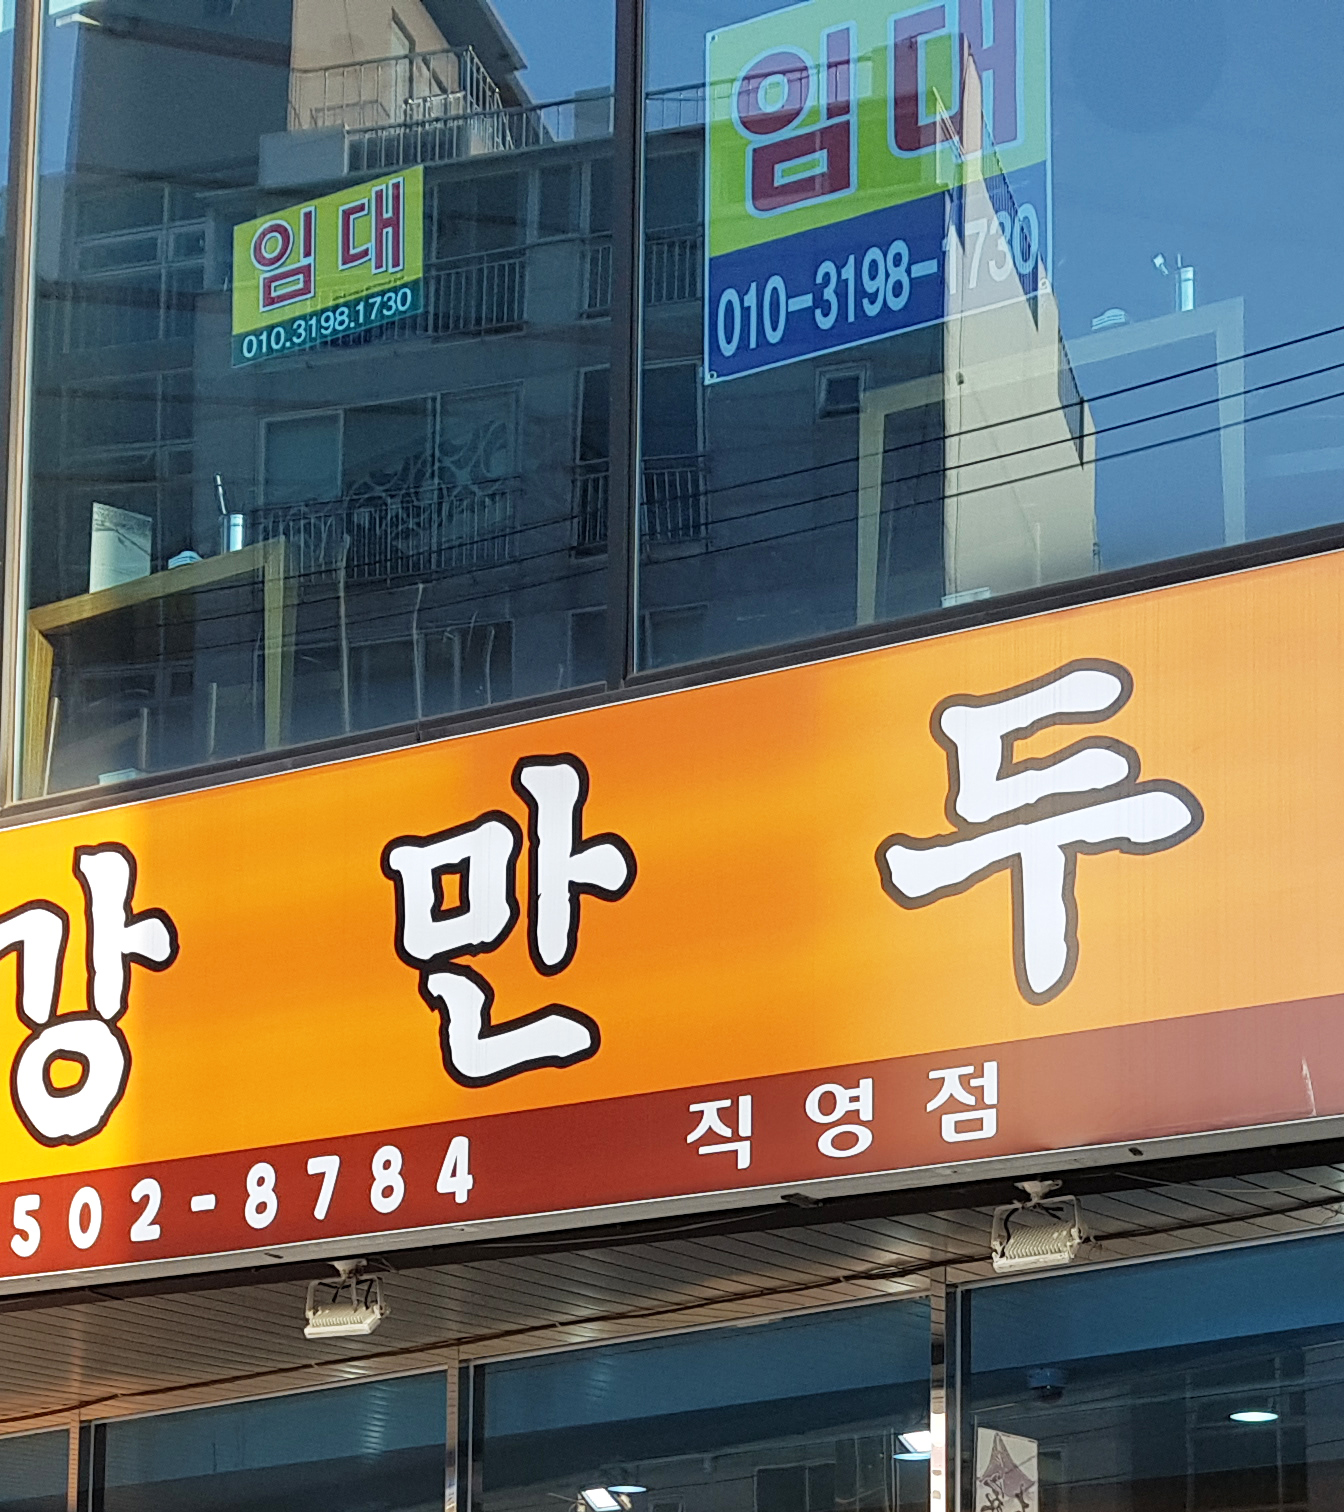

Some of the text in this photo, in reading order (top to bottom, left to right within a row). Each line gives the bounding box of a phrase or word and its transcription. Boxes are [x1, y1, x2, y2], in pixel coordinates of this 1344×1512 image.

[731, 0, 1025, 219] 임대
[251, 176, 404, 312] 임대
[717, 203, 1039, 357] 010-3198-1730
[242, 288, 411, 358] 010.3198.1730
[686, 1061, 1000, 1169] 직영점
[11, 1135, 474, 1258] 502-8784
